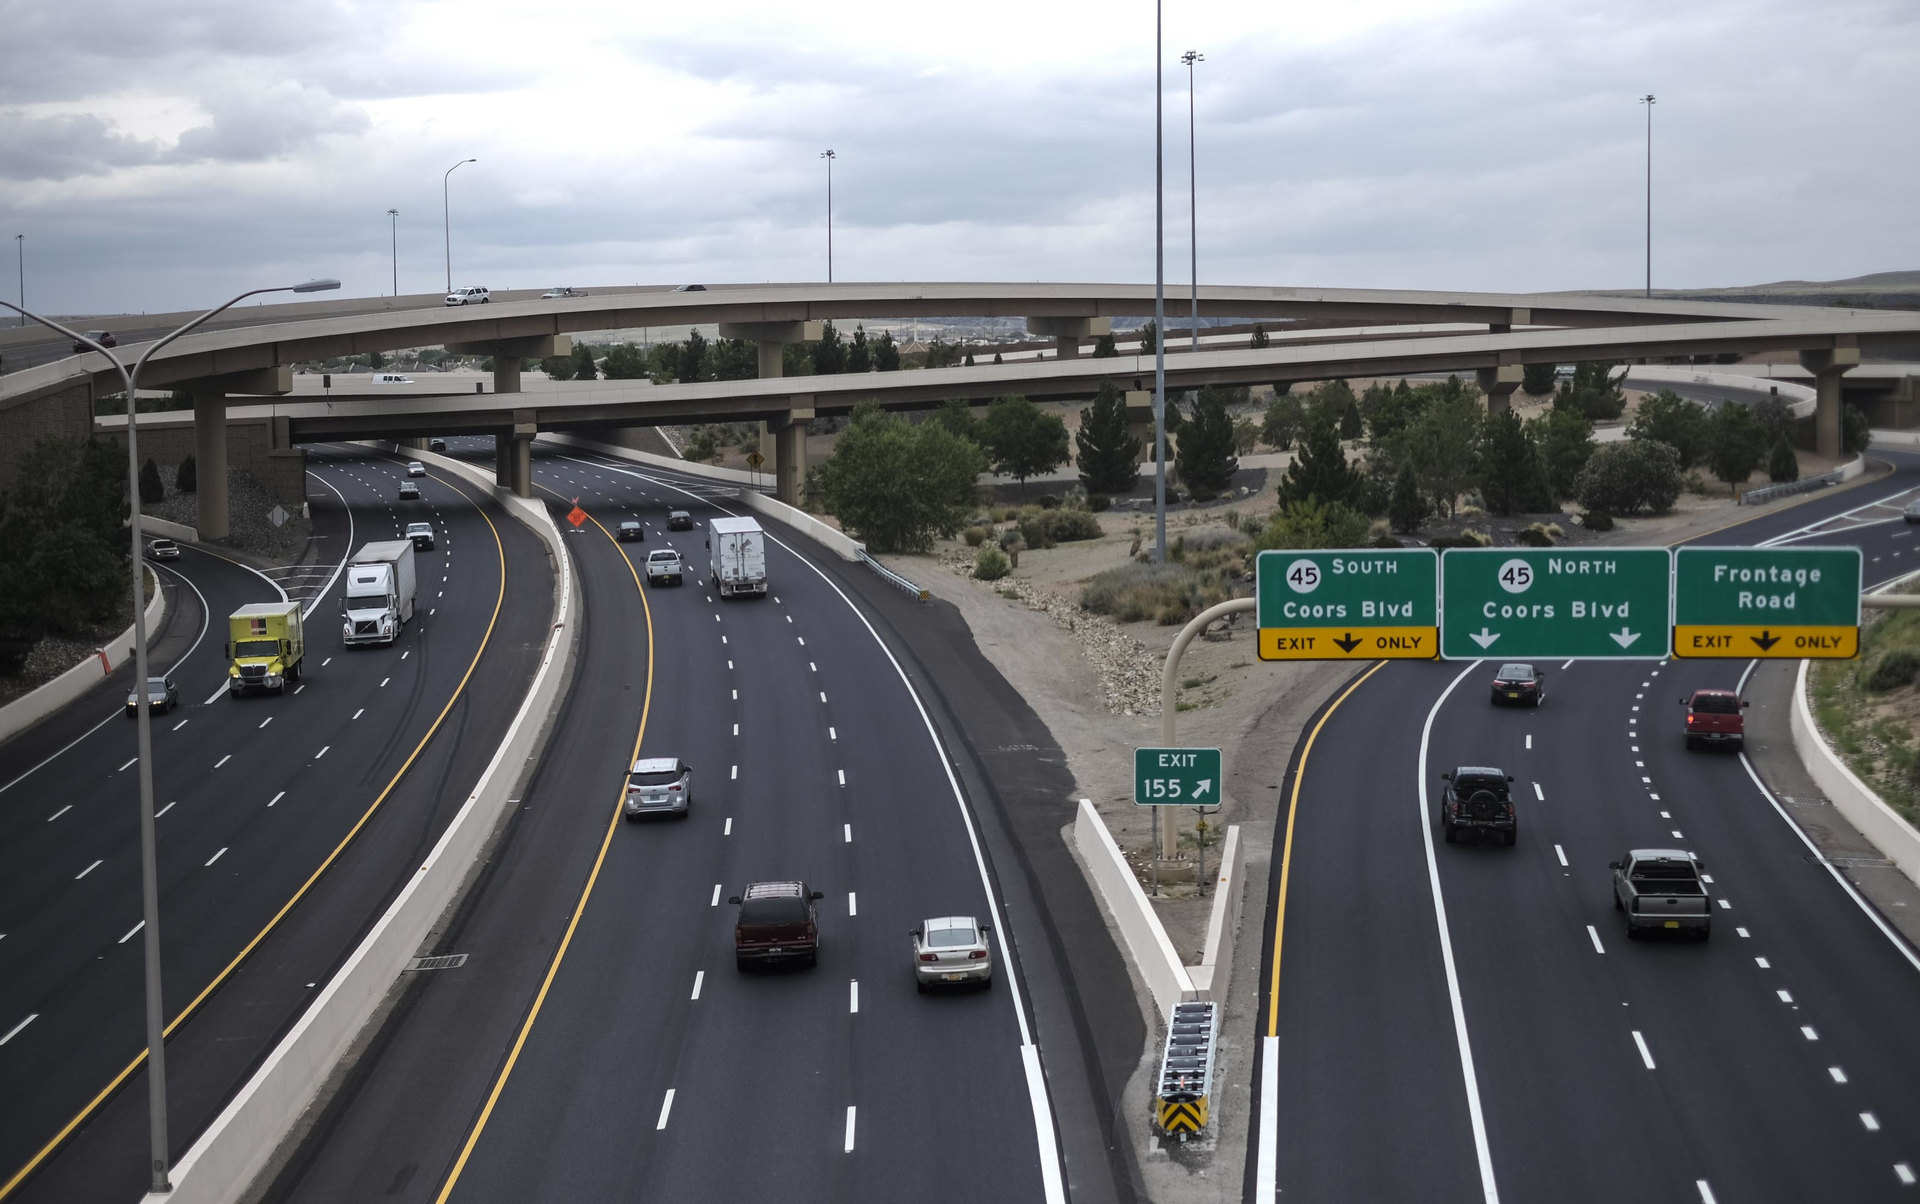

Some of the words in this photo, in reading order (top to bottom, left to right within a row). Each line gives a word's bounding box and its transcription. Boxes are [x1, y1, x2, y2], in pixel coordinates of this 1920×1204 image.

[1290, 567, 1317, 586] 45
[1333, 559, 1397, 574] SOUTH
[1502, 567, 1529, 586] 45
[1549, 559, 1616, 574] NORTH
[1715, 565, 1821, 587] Frontage
[1739, 592, 1796, 608] Road
[1284, 602, 1347, 618] Coors
[1362, 601, 1412, 617] Blvd
[1483, 602, 1554, 618] Coors
[1572, 602, 1629, 617] Blvd
[1278, 637, 1316, 650] EXIT
[1377, 637, 1422, 649] ONLY
[1693, 636, 1733, 648] EXIT
[1795, 636, 1842, 648] ONLY
[1159, 754, 1197, 767] EXIT
[1144, 779, 1182, 798] 155
